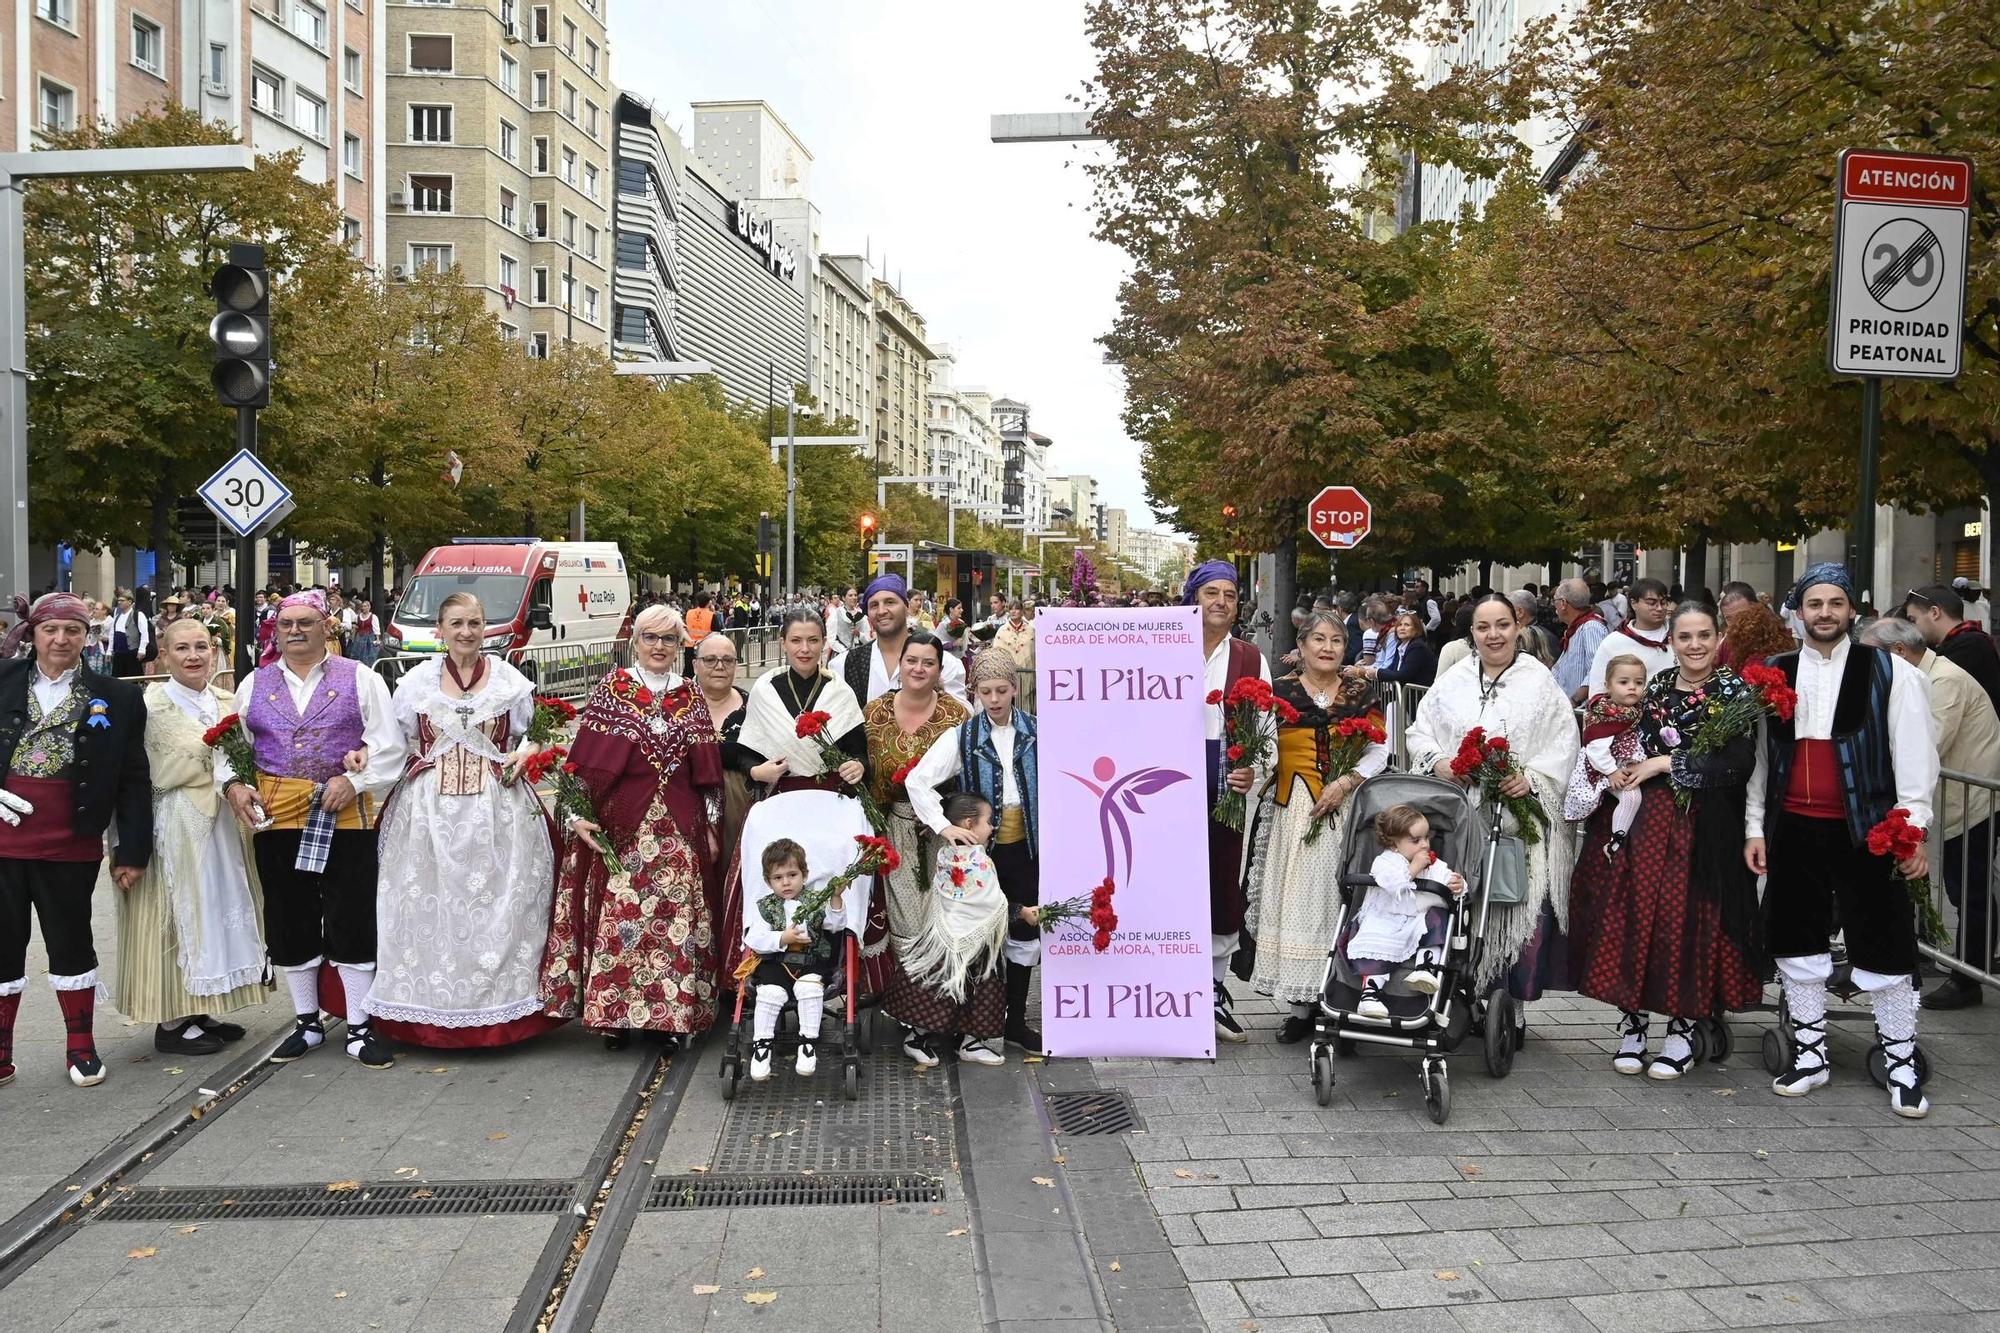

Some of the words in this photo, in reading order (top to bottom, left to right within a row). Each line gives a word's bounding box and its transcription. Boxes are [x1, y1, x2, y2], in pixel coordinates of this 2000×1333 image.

[1858, 169, 1955, 191] ATENCIÓN
[737, 200, 748, 237] El
[1872, 243, 1934, 287] 20
[1849, 318, 1949, 339] PRIORIDAD
[1849, 344, 1946, 364] PEATONAL
[224, 477, 265, 508] 30
[1315, 510, 1364, 525] STOP
[590, 591, 603, 603] Cruz
[603, 589, 615, 605] Roja
[1055, 621, 1120, 631] ASOCIACIÓN
[1122, 622, 1136, 631] DE
[1138, 622, 1183, 631] MUJERES
[1044, 634, 1087, 645] CABRA
[1089, 634, 1104, 645] DE
[1108, 633, 1148, 646] MORA,
[1152, 633, 1194, 644] TERUEL
[1048, 667, 1086, 701] El
[1100, 666, 1194, 701] Pilar
[1129, 932, 1141, 941] DE
[1145, 931, 1191, 941] MUJERES
[1049, 944, 1091, 956] CABRA
[1113, 944, 1155, 957] MORA,
[1158, 943, 1202, 955] TERUEL
[1054, 983, 1092, 1019] El
[1107, 982, 1203, 1018] Pilar
